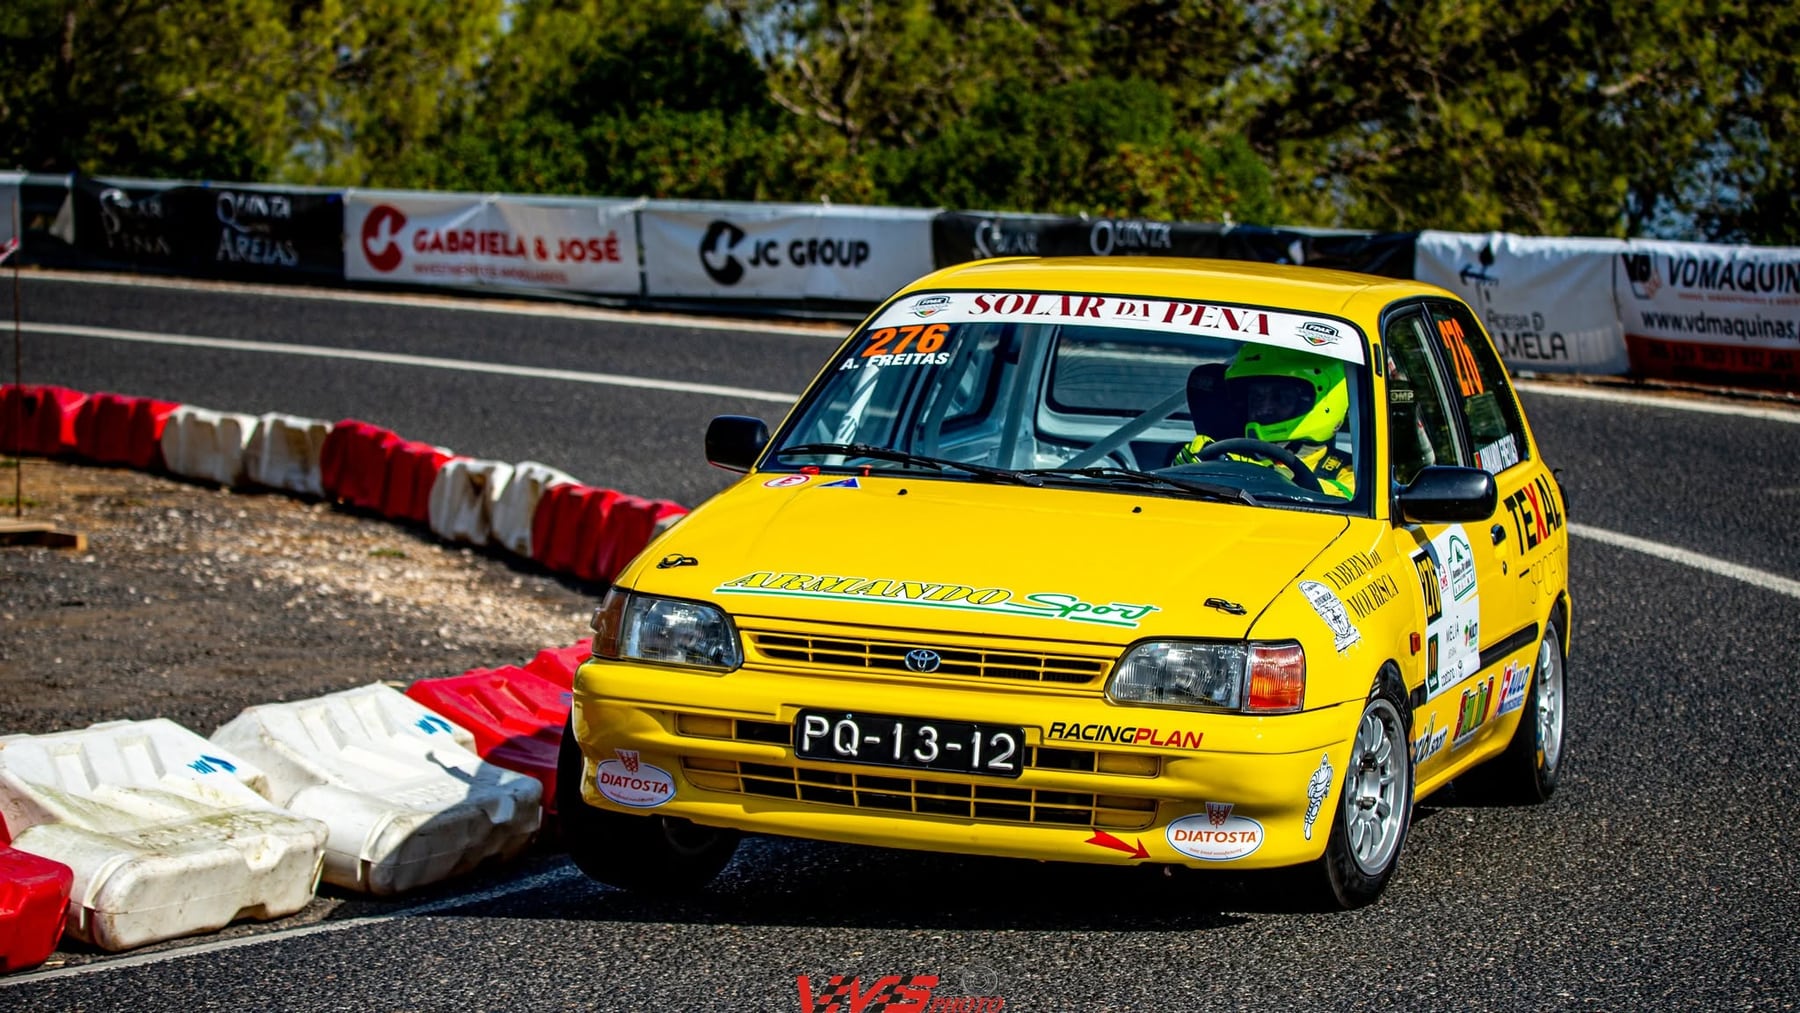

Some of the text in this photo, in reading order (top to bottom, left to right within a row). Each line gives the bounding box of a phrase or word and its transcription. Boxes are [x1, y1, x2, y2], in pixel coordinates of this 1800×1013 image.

[412, 228, 621, 263] GABRIELA & JOSÉ
[748, 239, 780, 267] JC
[968, 293, 1271, 336] SOLAR DA PENA
[1641, 311, 1800, 342] www.vdmaquinas.
[861, 323, 950, 358] 276
[1438, 318, 1484, 397] 276
[839, 352, 950, 371] A. FREITAS
[1503, 474, 1562, 556] TEXAL
[1323, 551, 1374, 590] TABERNA
[1417, 556, 1441, 618] 276
[724, 571, 1160, 620] ARMANDO Sport
[1346, 572, 1399, 621] MOURISCA
[801, 714, 1016, 771] PQ-13-12
[1047, 721, 1205, 750] RACINGPLAN
[600, 772, 669, 795] DIATOSTA
[1174, 829, 1257, 844] DIATOSTA
